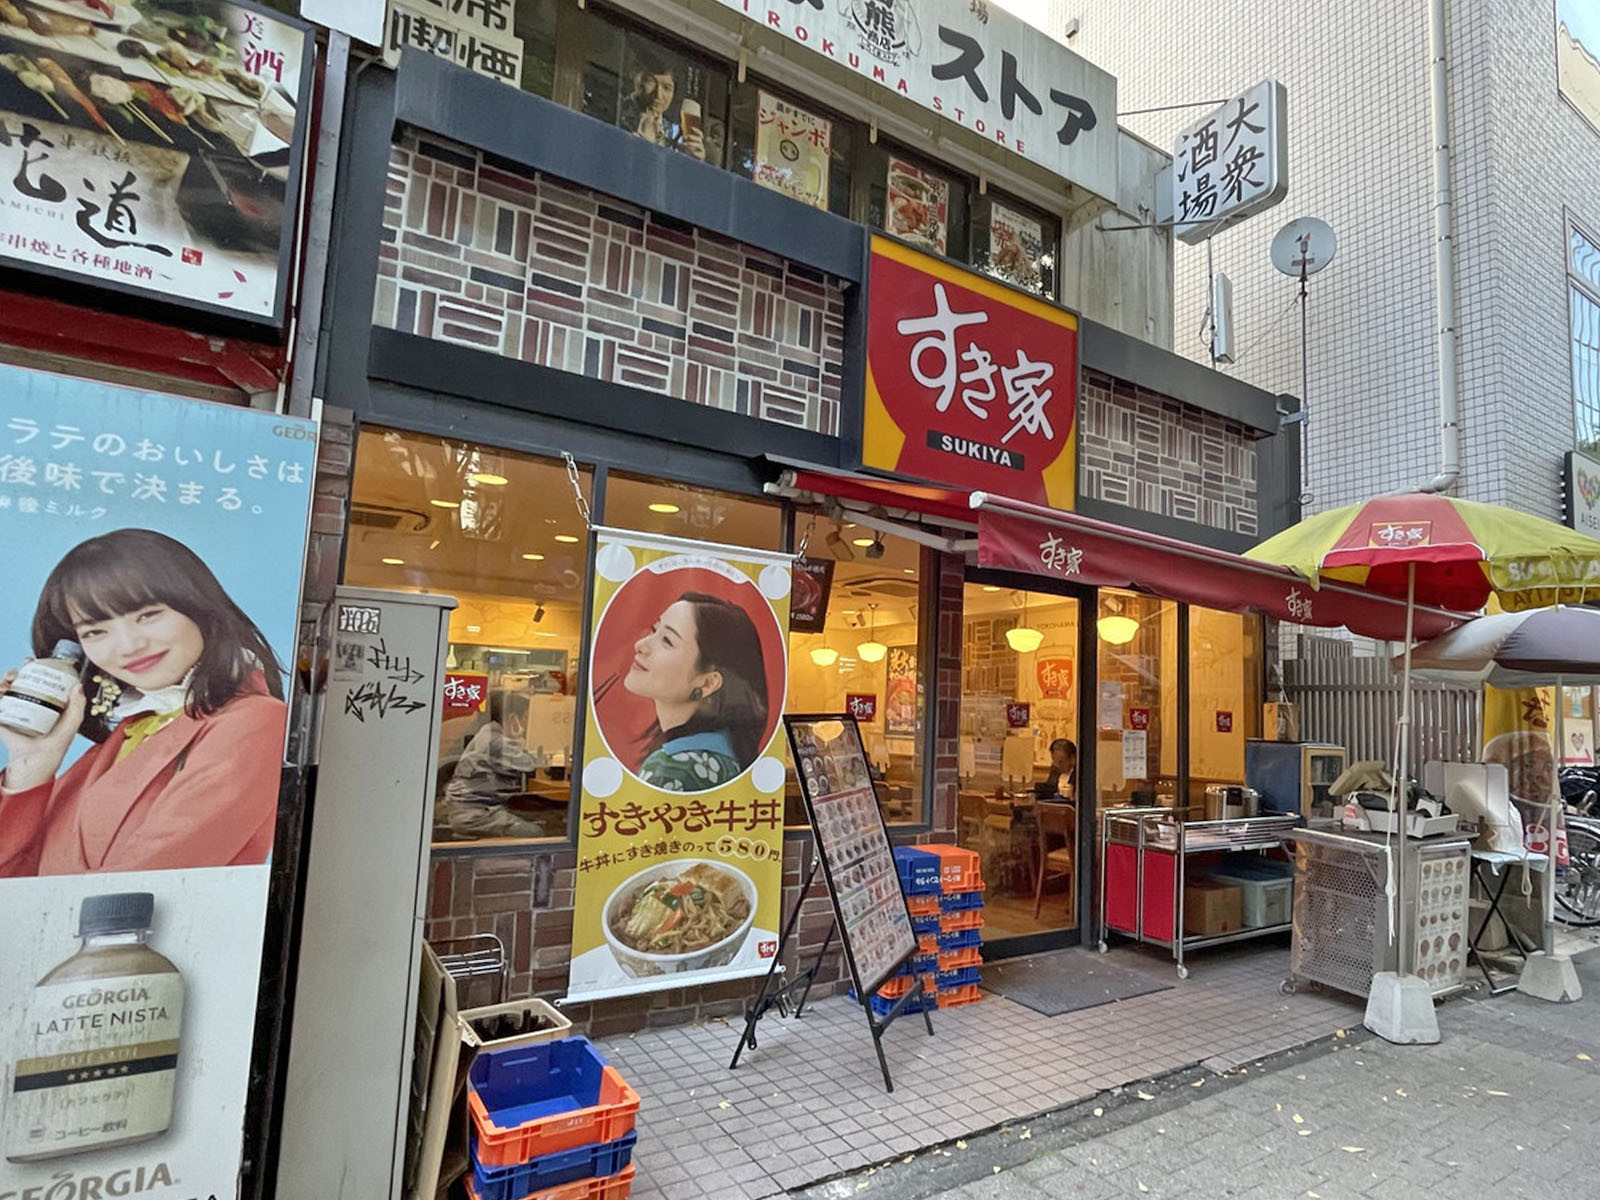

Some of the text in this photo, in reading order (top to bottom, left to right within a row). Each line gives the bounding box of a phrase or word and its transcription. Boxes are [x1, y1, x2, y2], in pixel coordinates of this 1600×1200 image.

[932, 24, 1097, 146] ストア
[934, 96, 1025, 154] STORE
[1220, 97, 1266, 203] 大衆
[1178, 118, 1219, 222] 酒場
[897, 282, 1055, 444] すき家
[7, 417, 304, 484] ラテのおいしさは
[941, 435, 1012, 467] SUKIYA
[0, 455, 263, 514] 後味で決まる。
[1039, 532, 1083, 576] すき家
[1286, 587, 1313, 621] すき家
[445, 677, 481, 702] すき家
[583, 800, 782, 838] すきやき牛丼
[36, 1006, 168, 1036] LATTE NISTA
[62, 987, 150, 1010] GEORGIA
